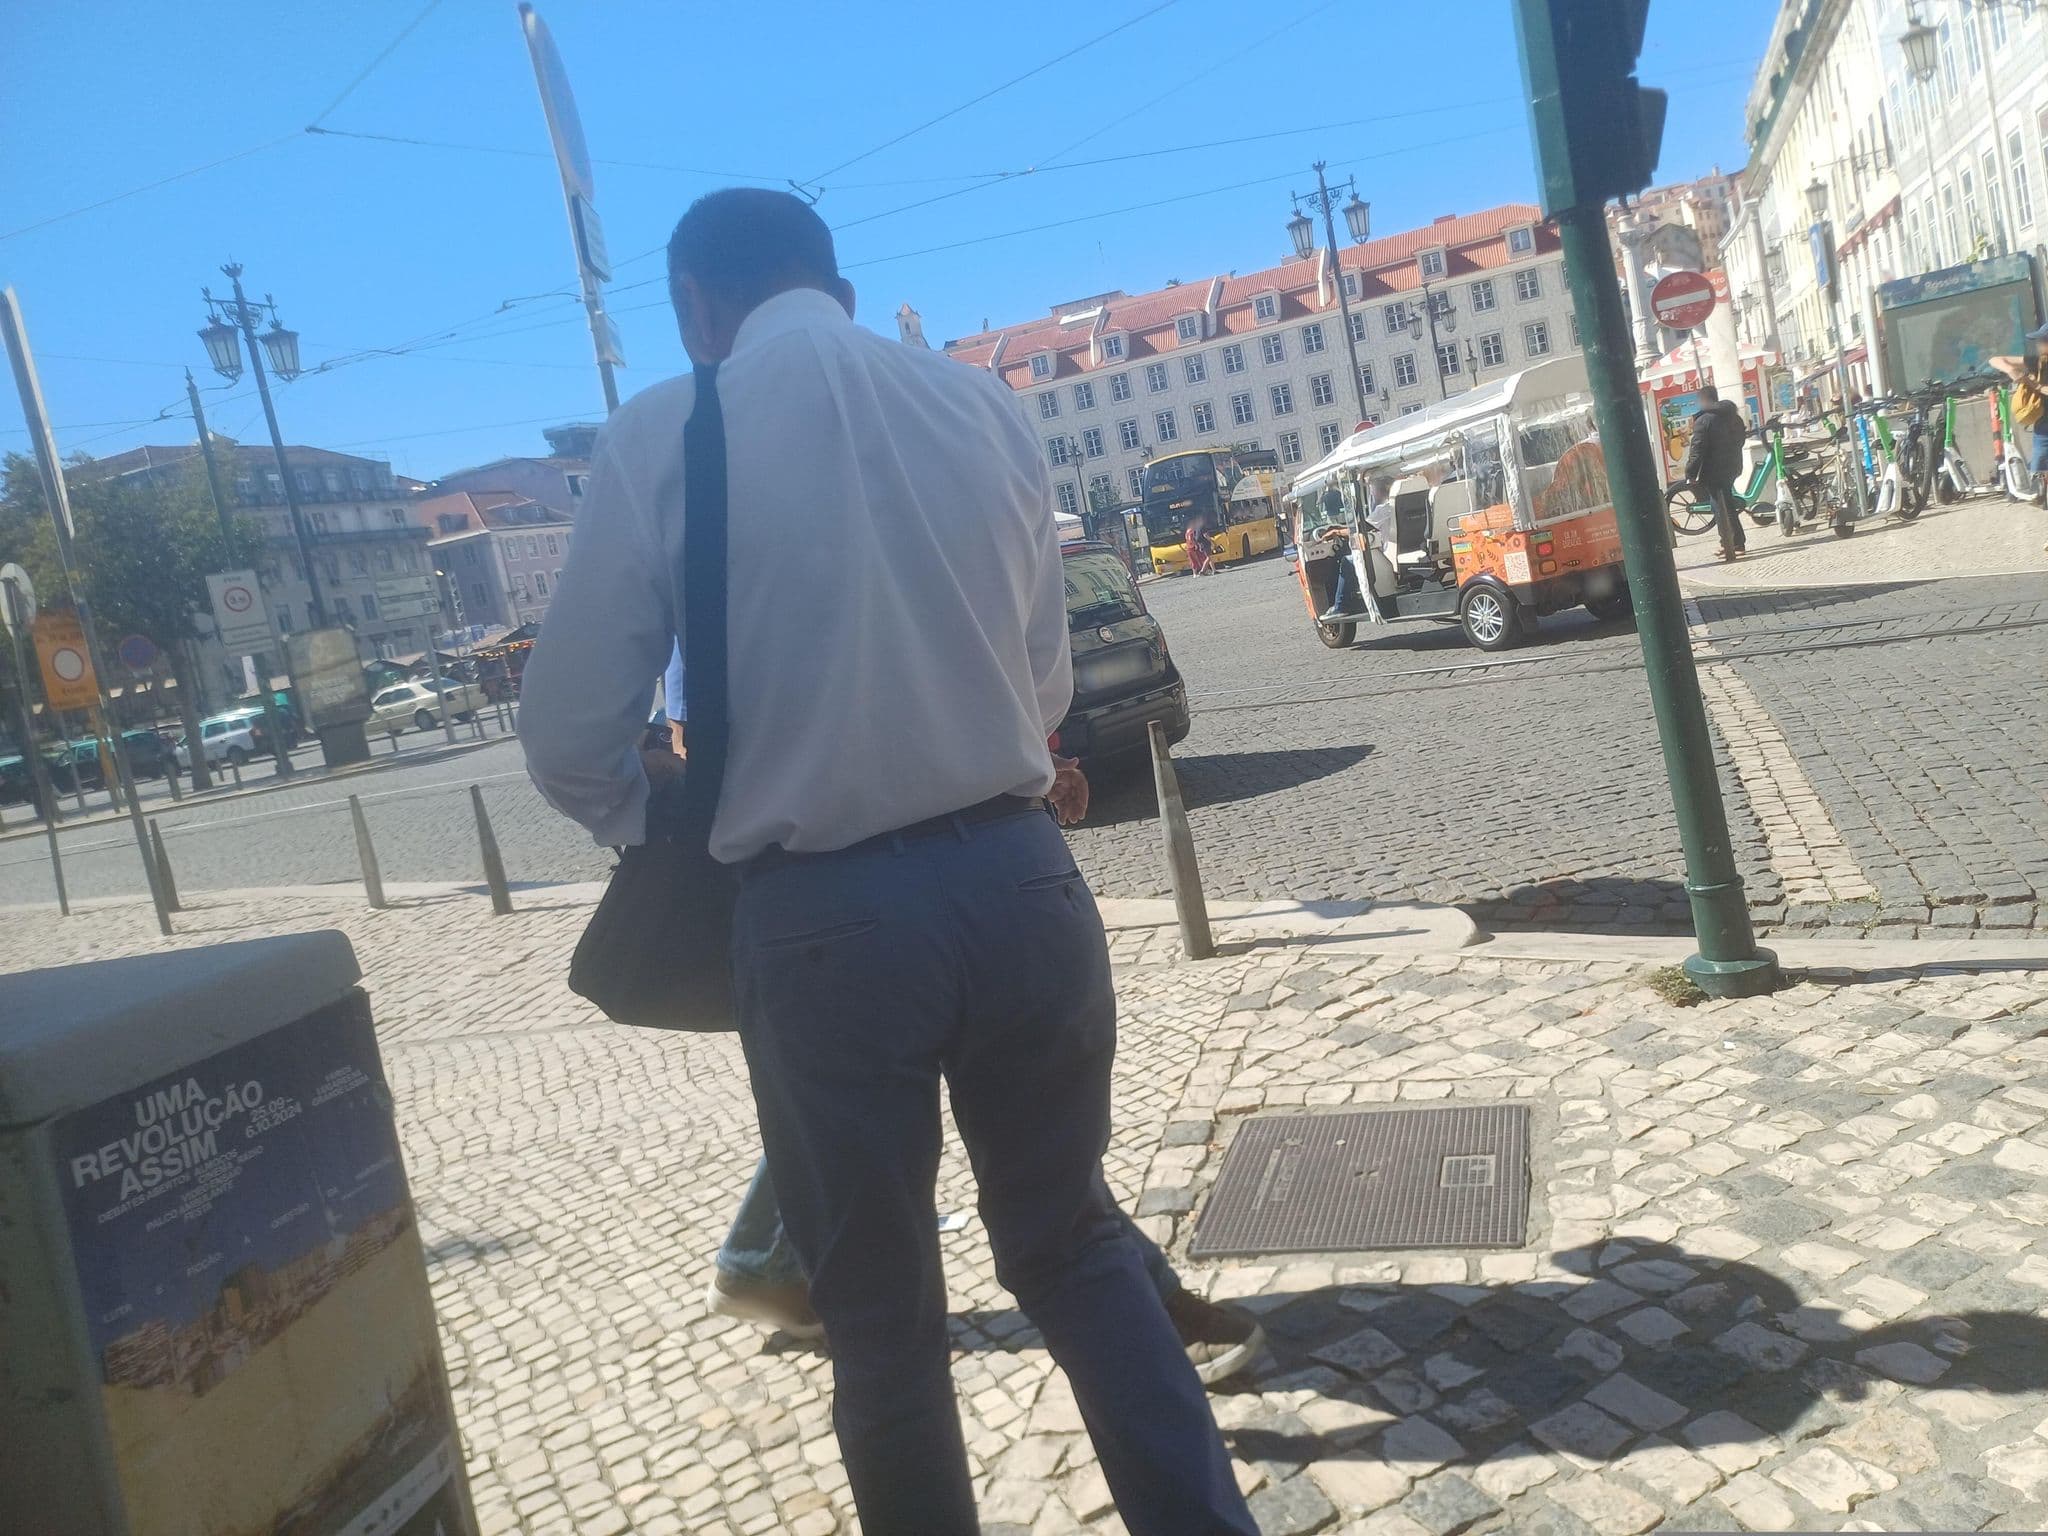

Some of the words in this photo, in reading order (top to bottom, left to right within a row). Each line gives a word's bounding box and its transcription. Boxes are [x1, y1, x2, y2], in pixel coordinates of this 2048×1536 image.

[71, 1080, 263, 1188] REVOLUÇÃO
[135, 1077, 207, 1127] UMA
[120, 1129, 218, 1200] ASSIM
